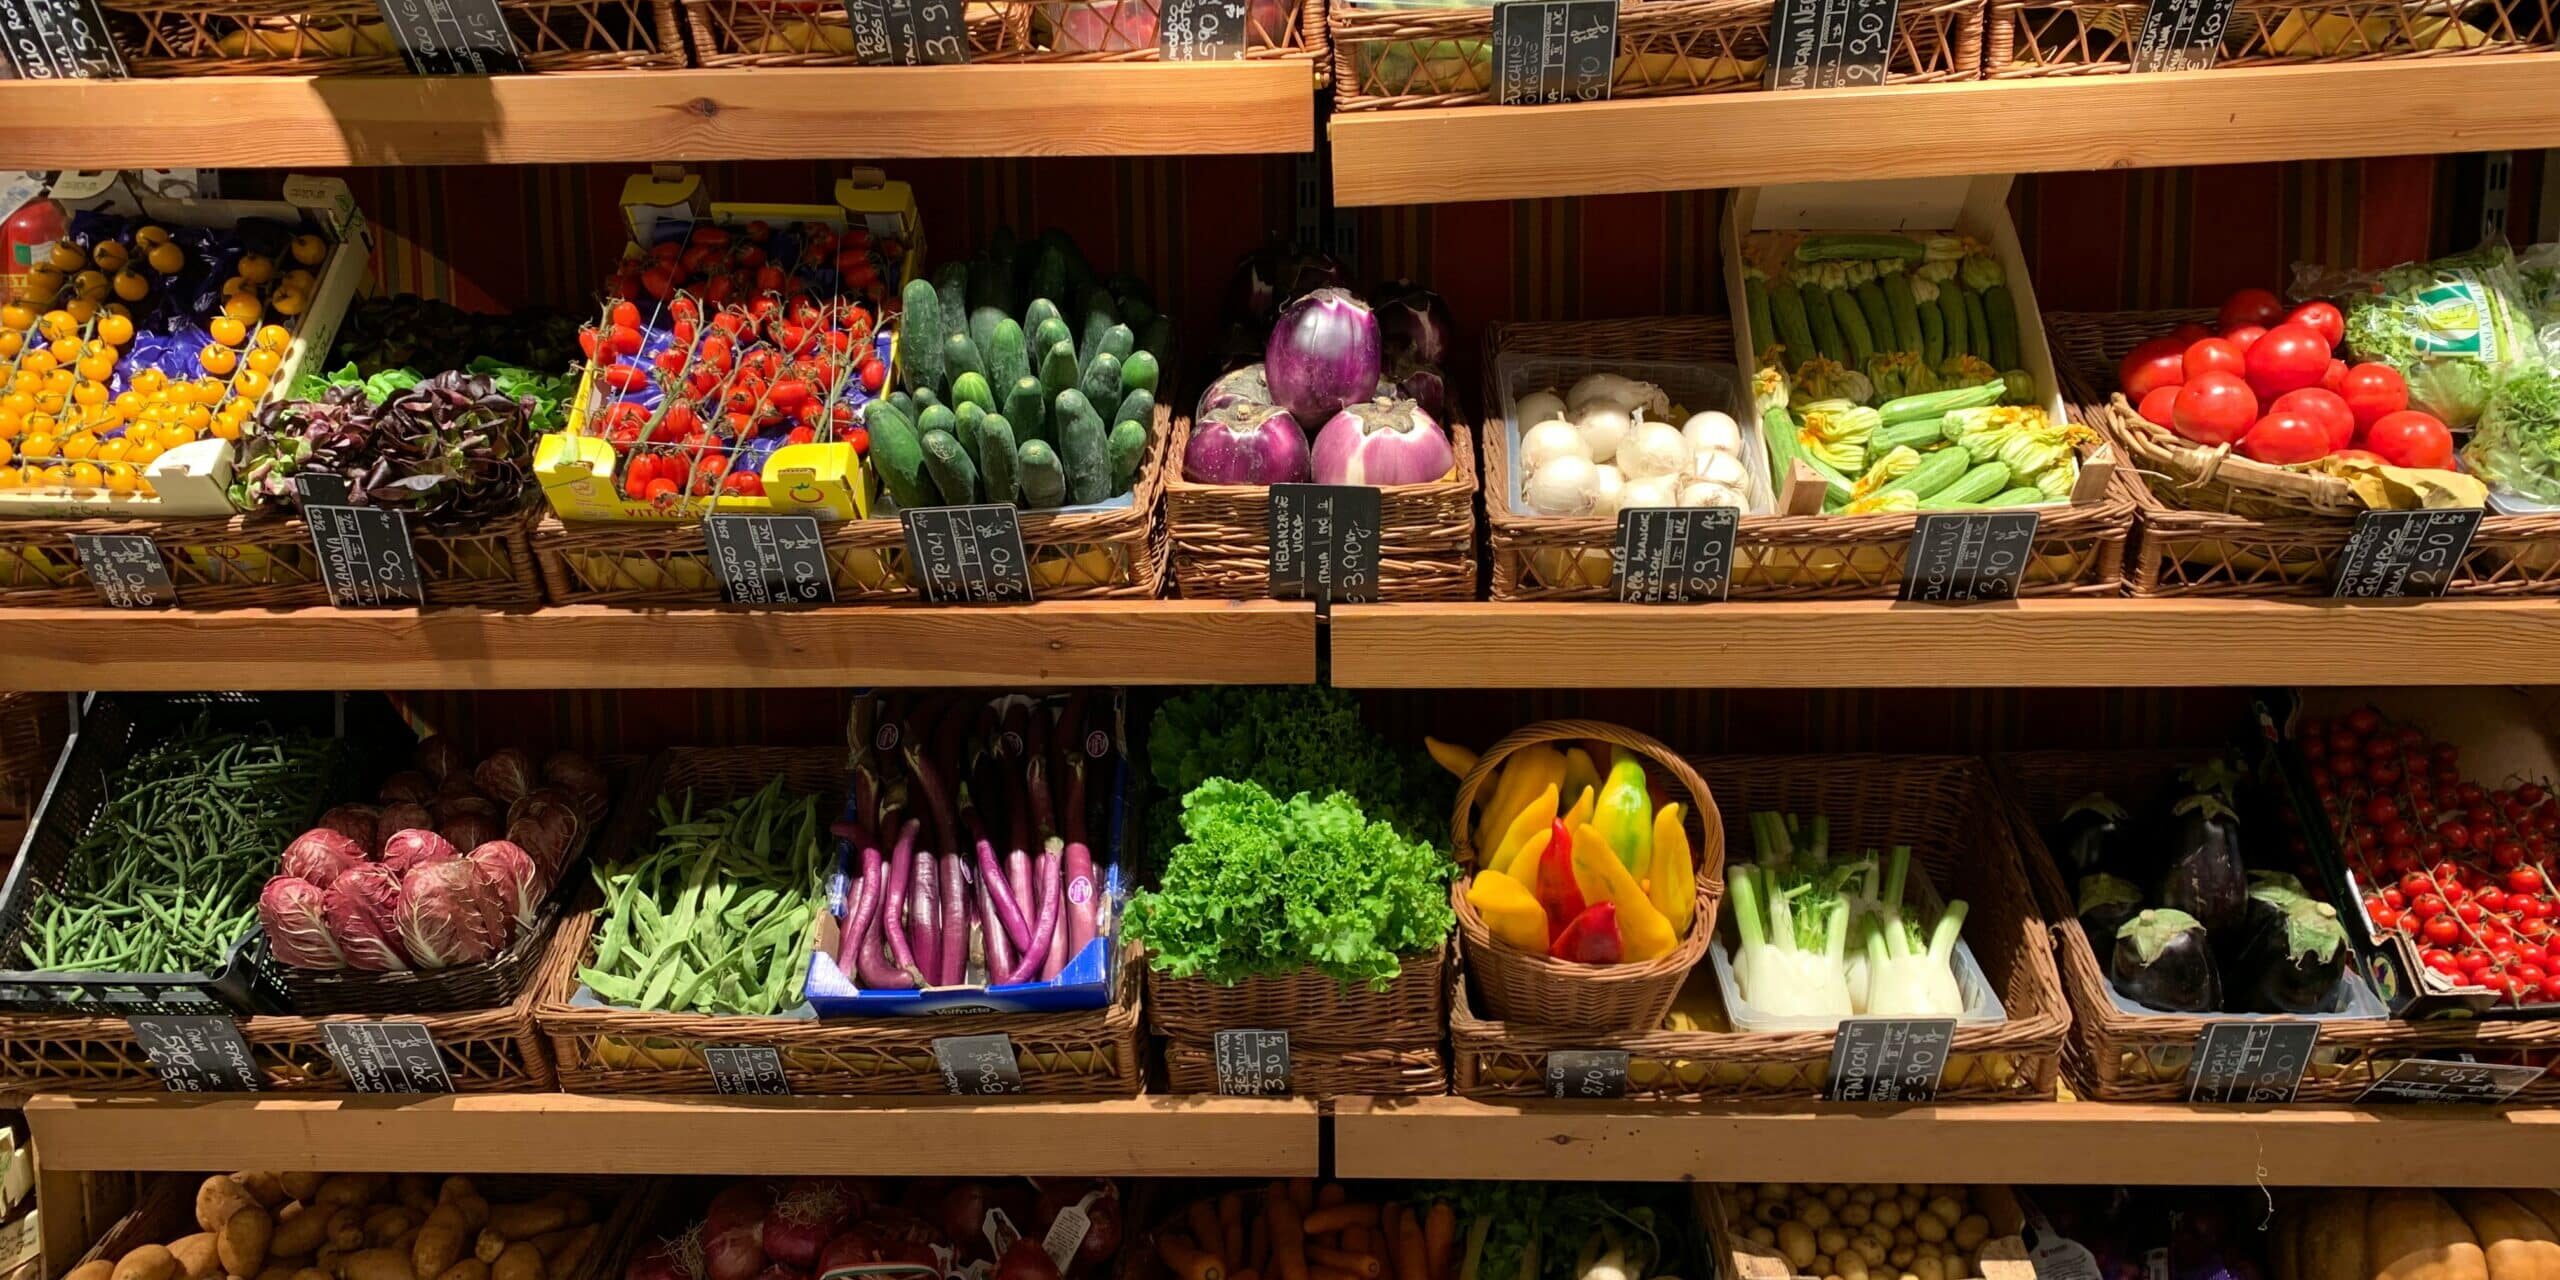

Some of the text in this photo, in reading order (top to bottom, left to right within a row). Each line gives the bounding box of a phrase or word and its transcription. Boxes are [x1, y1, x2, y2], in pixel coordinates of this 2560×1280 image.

[852, 0, 875, 57] PEPER
[902, 23, 920, 66] TALIA
[624, 508, 702, 519] VITTORI
[723, 545, 752, 603] OMODORO
[224, 1040, 257, 1092] FAGIOLI
